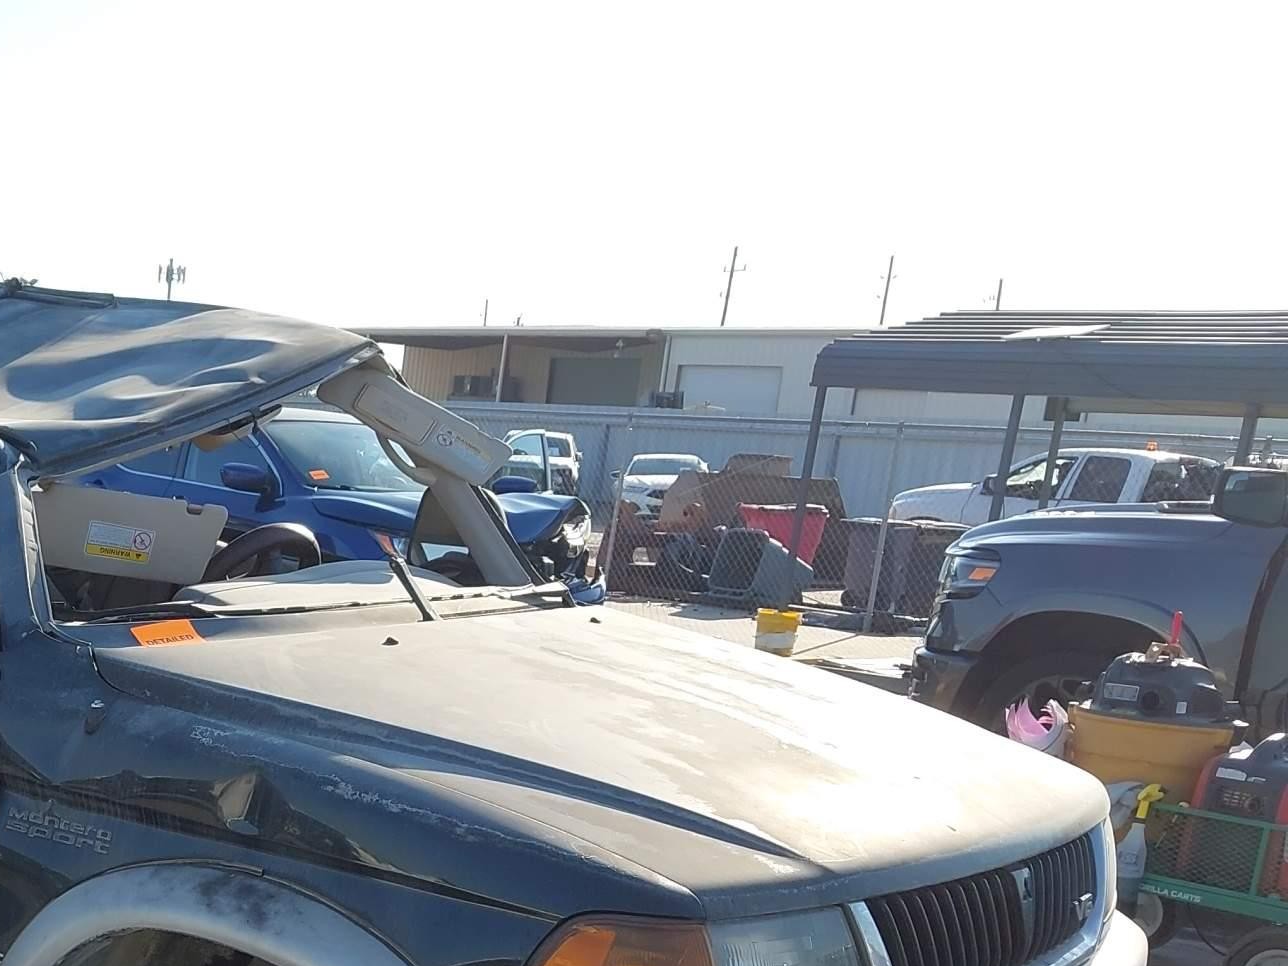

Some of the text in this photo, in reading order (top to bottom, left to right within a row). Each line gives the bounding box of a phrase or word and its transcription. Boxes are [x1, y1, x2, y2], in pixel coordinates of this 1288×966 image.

[99, 547, 131, 558] WARNING
[146, 634, 194, 646] DETAILED
[1171, 890, 1201, 903] CARTS
